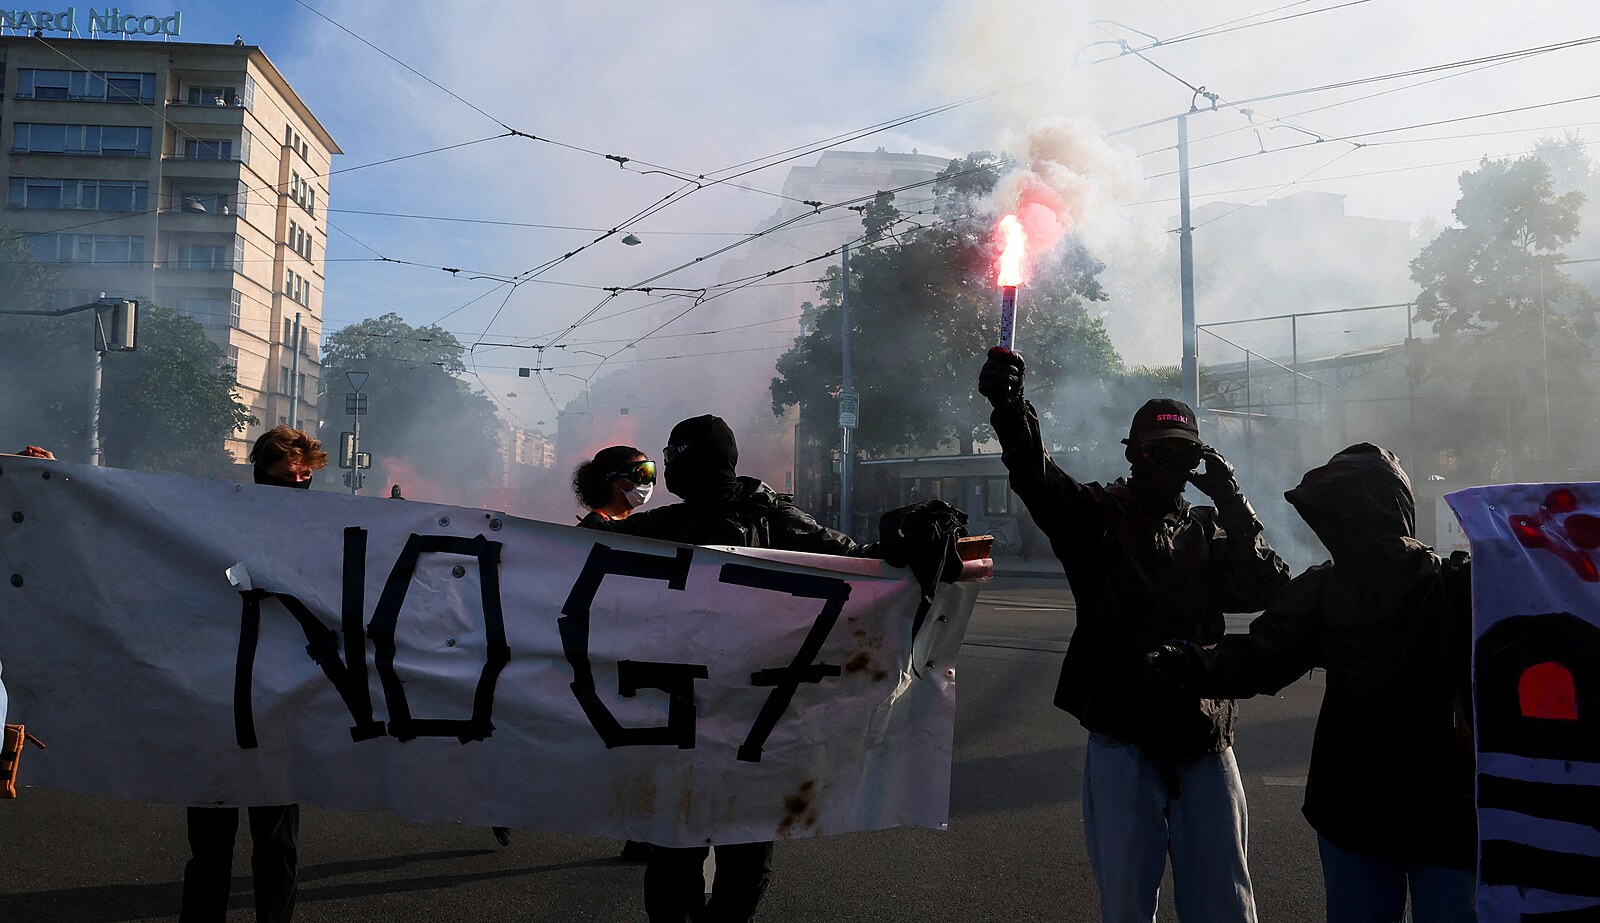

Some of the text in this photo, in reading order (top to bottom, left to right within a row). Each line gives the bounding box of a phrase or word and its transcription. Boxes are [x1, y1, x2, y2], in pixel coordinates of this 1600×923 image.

[89, 8, 182, 35] Nicod
[234, 526, 852, 762] NO G7
